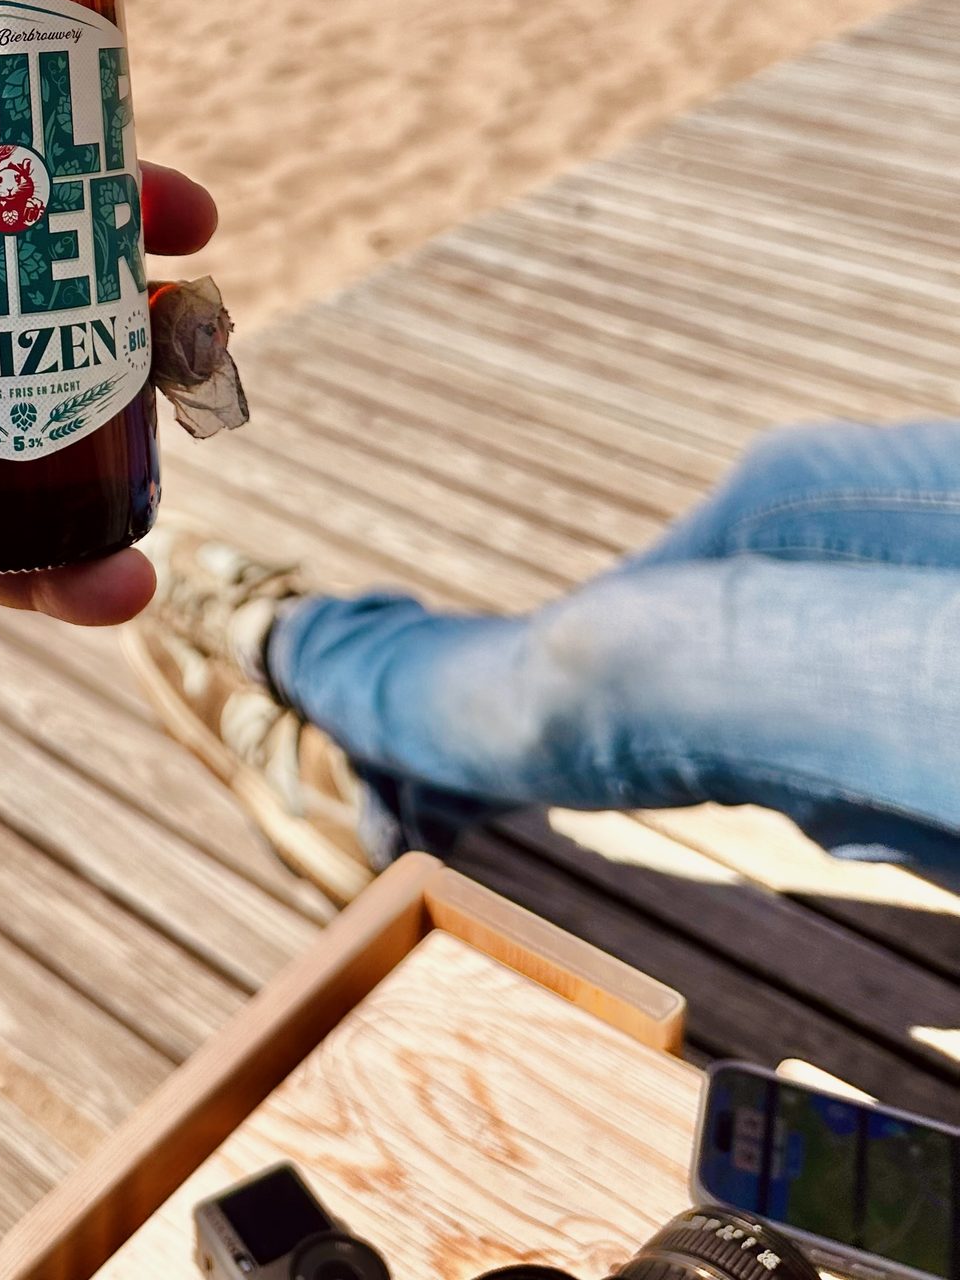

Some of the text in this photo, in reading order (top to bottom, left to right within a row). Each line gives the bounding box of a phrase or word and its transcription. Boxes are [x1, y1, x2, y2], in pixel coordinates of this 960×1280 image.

[128, 327, 147, 352] BIO
[9, 387, 34, 399] FRIS
[36, 386, 48, 396] EN
[50, 380, 81, 395] ZACHT
